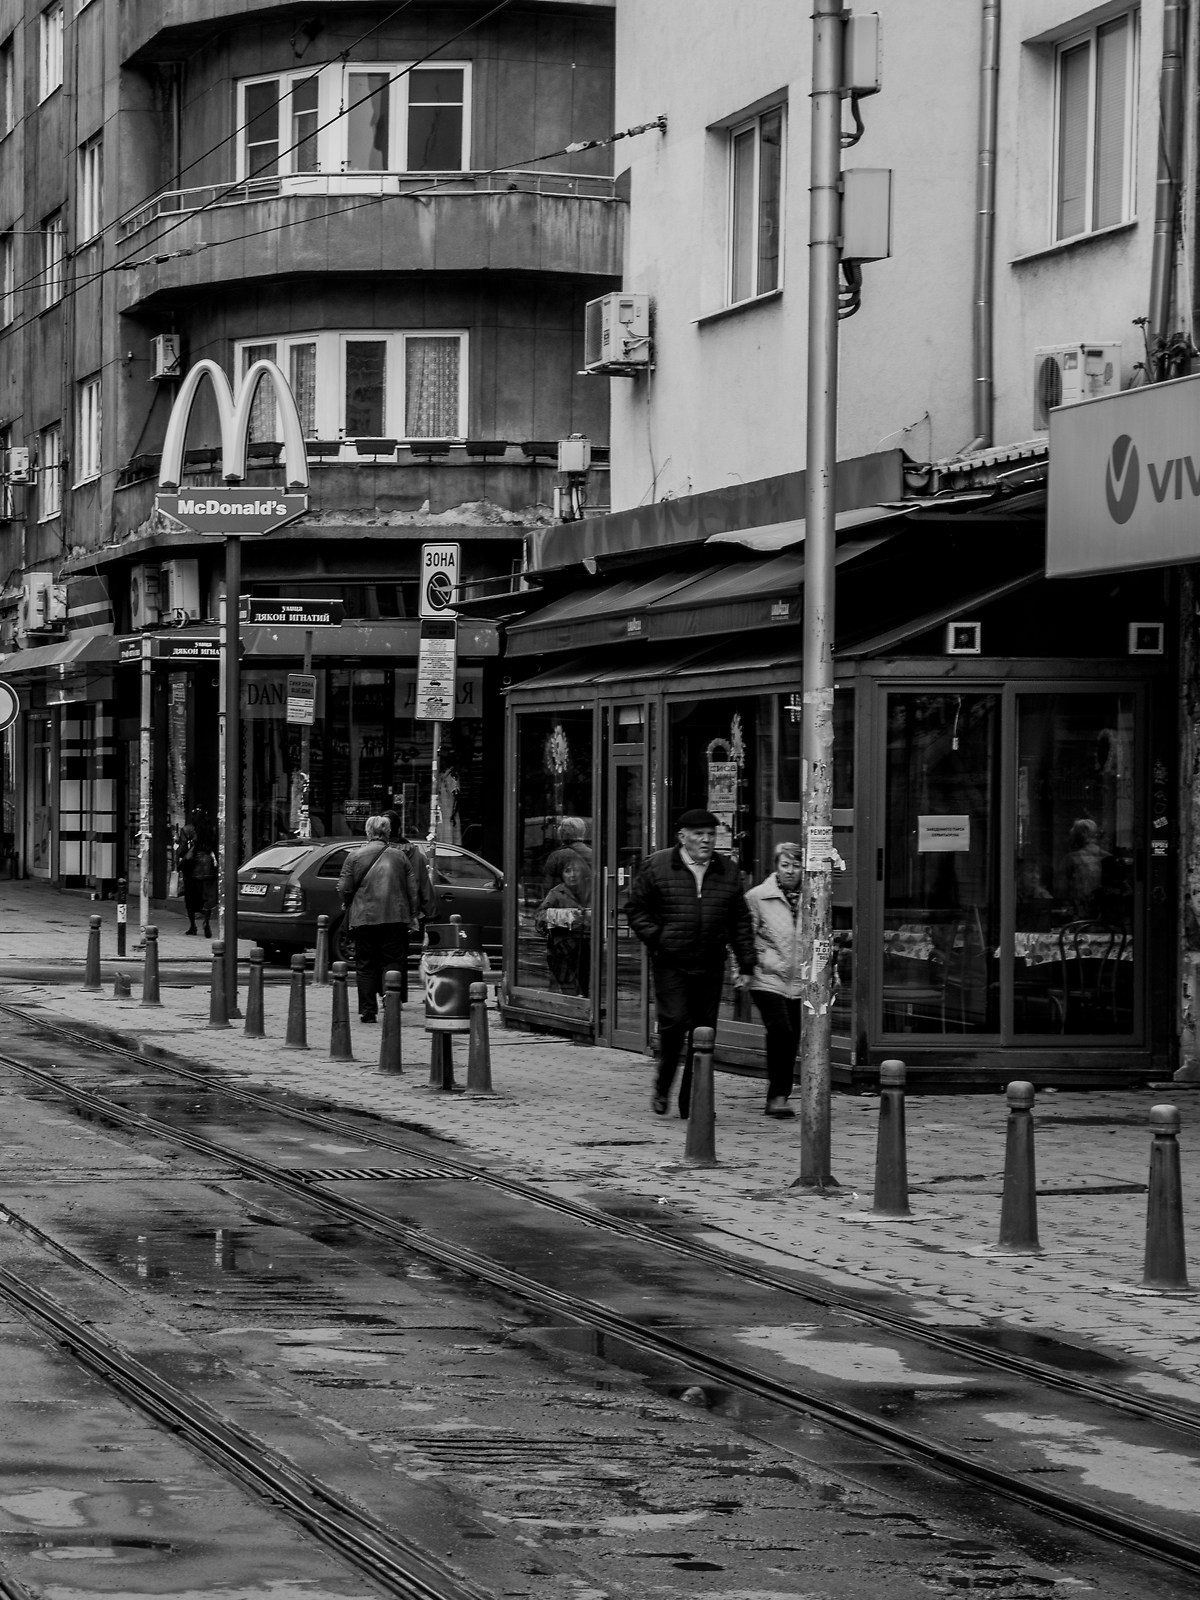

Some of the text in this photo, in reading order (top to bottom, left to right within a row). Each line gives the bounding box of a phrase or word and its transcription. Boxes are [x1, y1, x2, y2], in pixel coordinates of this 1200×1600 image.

[178, 500, 287, 516] McDonald's
[425, 552, 456, 568] ЗОНА
[281, 605, 303, 613] улица
[254, 613, 286, 622] ДЯКОН
[288, 613, 330, 623] ИГНАТИЙ
[172, 648, 199, 656] ДЯКОН
[247, 683, 288, 705] DAN
